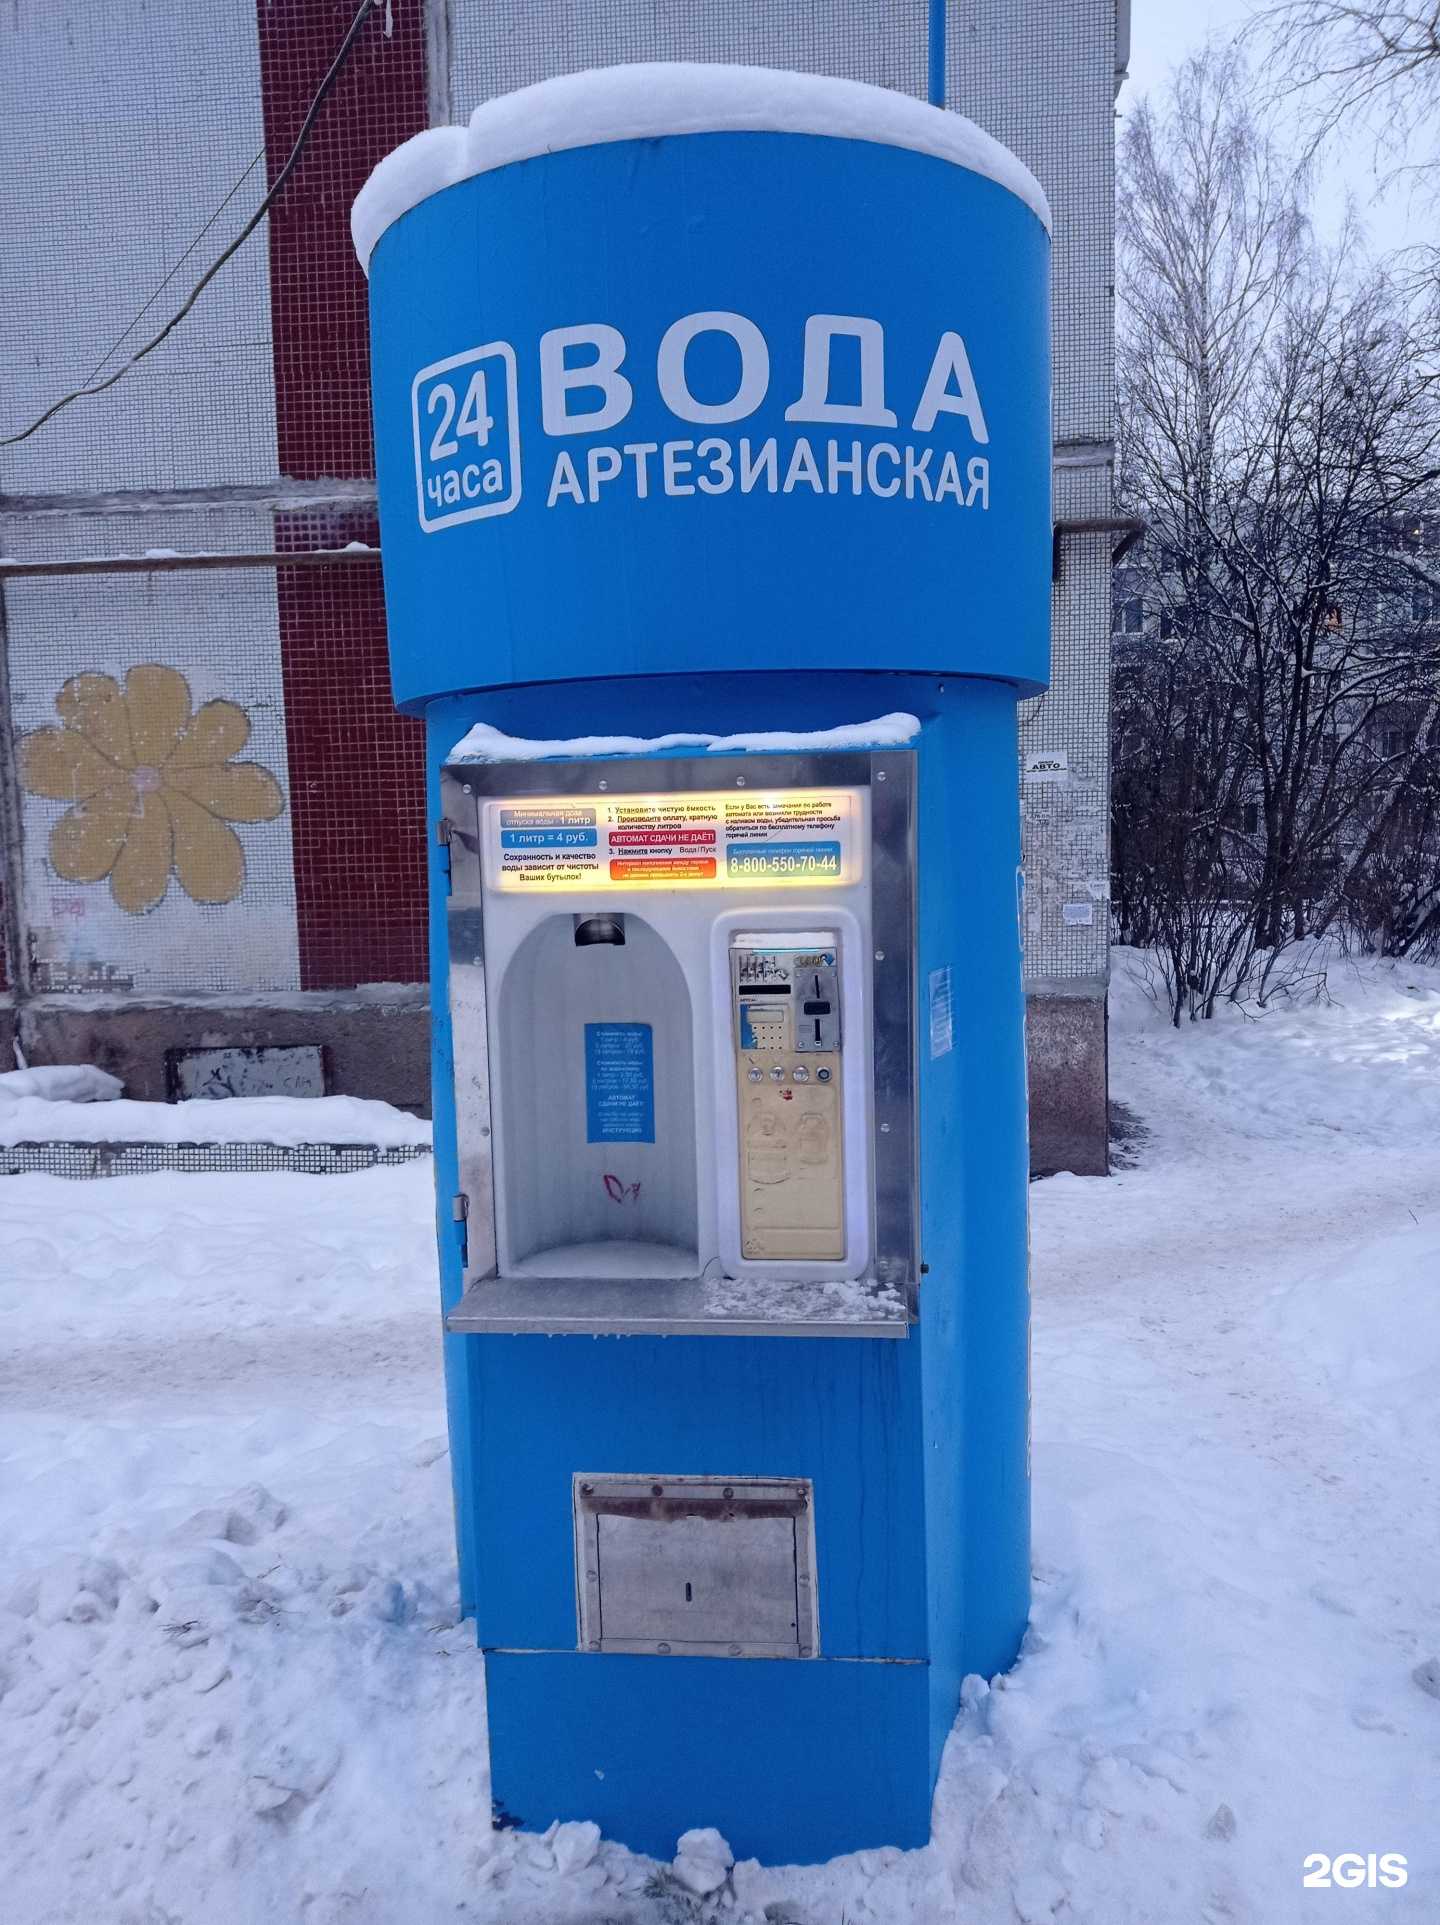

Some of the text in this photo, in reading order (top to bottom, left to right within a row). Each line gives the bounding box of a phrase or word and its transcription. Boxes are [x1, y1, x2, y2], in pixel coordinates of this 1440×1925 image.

[540, 311, 990, 444] ВОДА
[427, 369, 494, 462] 24
[546, 437, 990, 510] АРТЕЗИАНСКАЯ
[427, 459, 504, 508] часа
[658, 806, 684, 814] чистую
[568, 817, 591, 826] литр
[617, 815, 661, 823] Произведите
[689, 814, 718, 822] кратную
[816, 815, 841, 823] просьба
[807, 823, 835, 831] телефону
[510, 833, 515, 842] 1
[519, 834, 545, 844] литр
[556, 833, 563, 842] 4
[566, 831, 588, 844] руб.
[611, 834, 649, 843] АВТОМАТ
[650, 834, 677, 843] СДАЧИ
[679, 833, 690, 841] НЕ
[618, 847, 648, 856] Нажмите
[650, 847, 673, 855] кнопку
[504, 853, 553, 862] Сохранность
[502, 864, 523, 872] воды
[730, 855, 837, 873] 8-800-550-70-44
[520, 872, 581, 882] Ваших бутылок!
